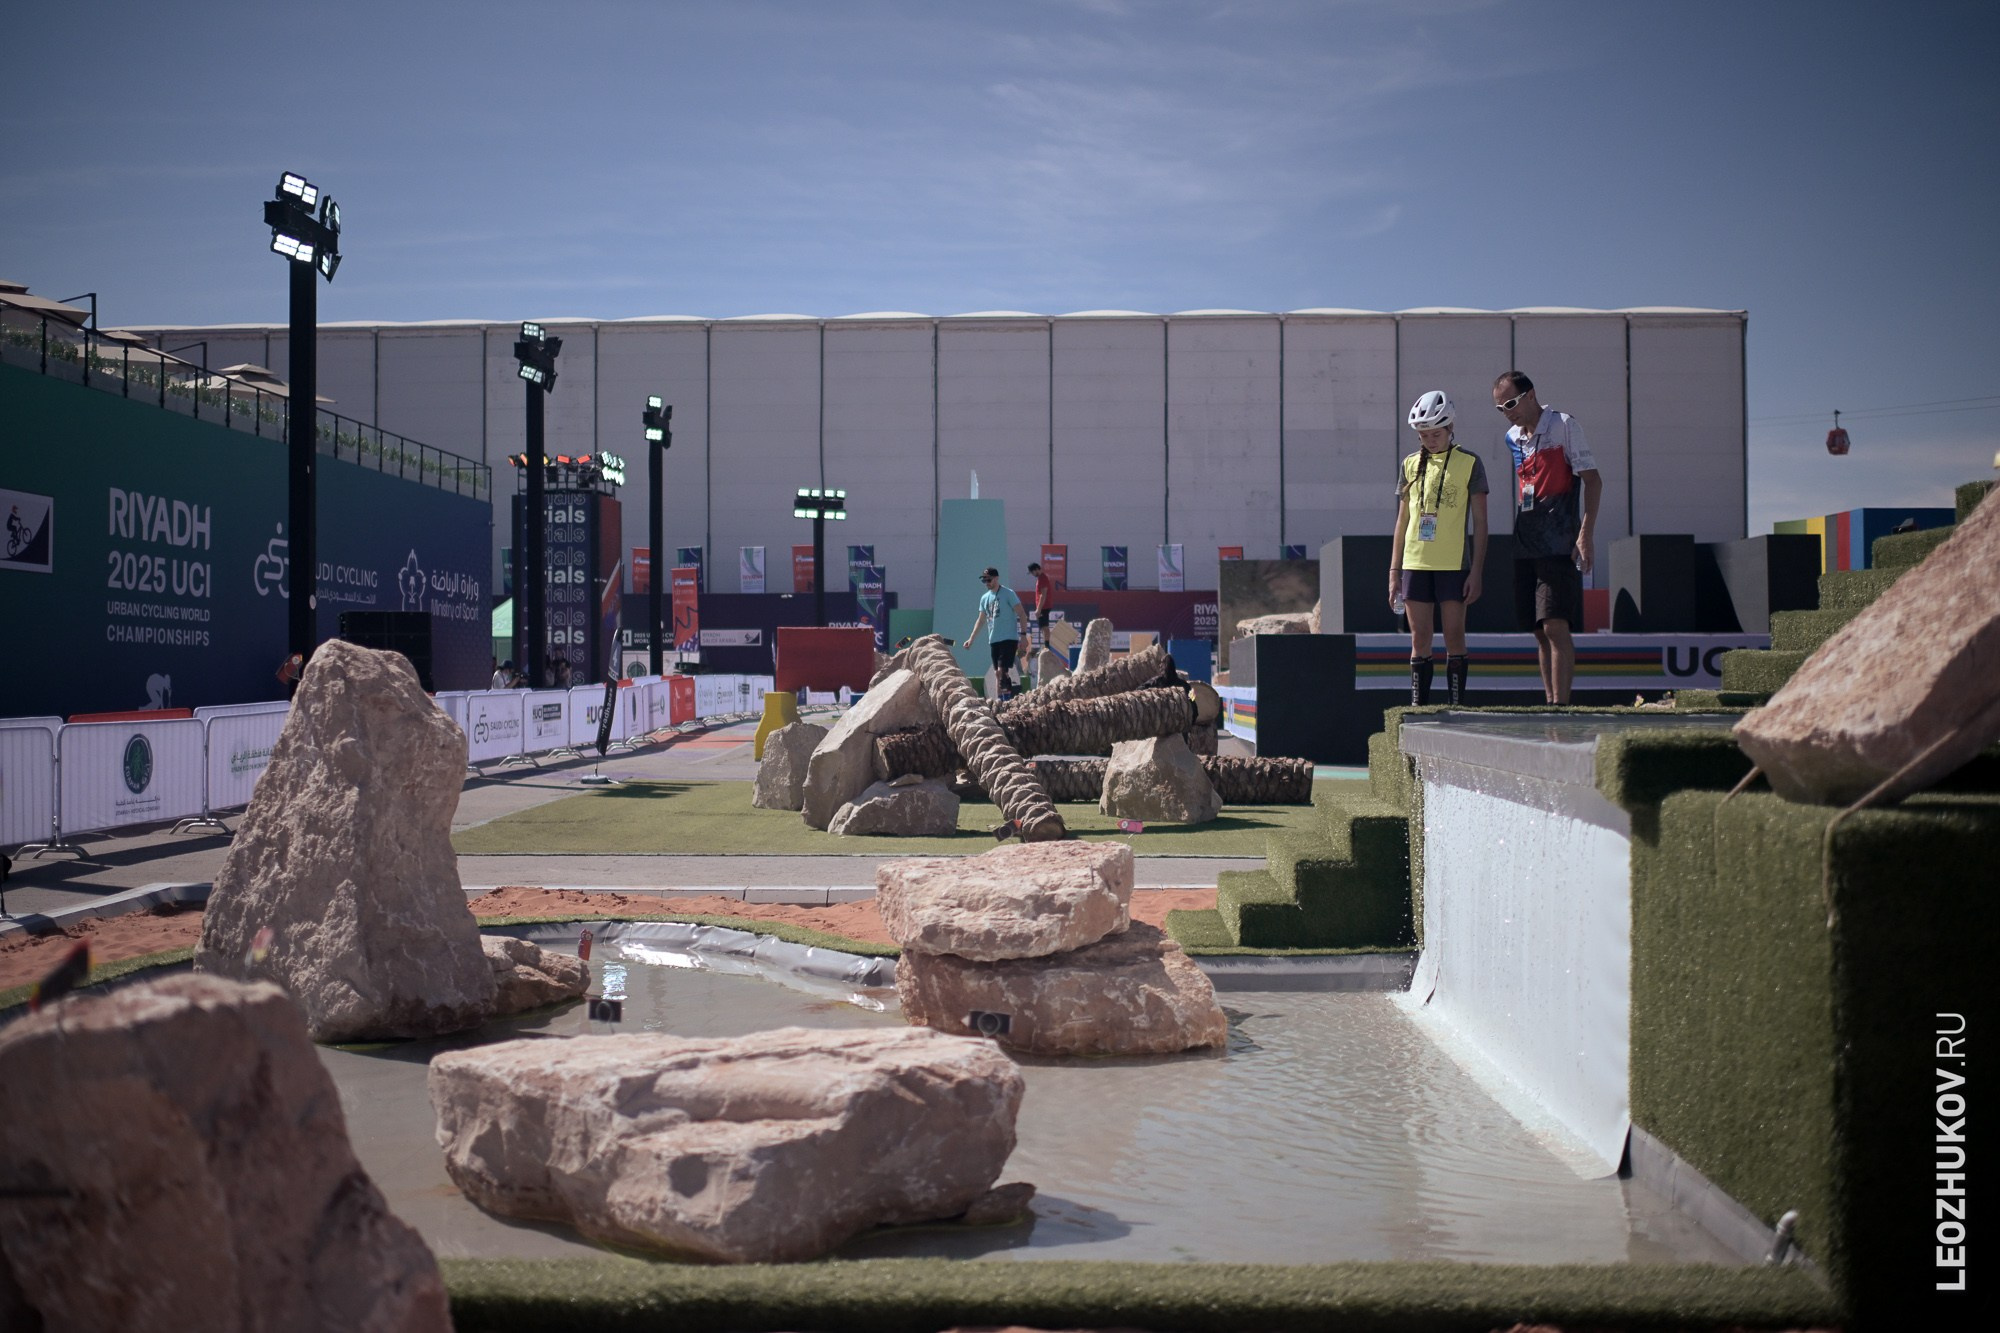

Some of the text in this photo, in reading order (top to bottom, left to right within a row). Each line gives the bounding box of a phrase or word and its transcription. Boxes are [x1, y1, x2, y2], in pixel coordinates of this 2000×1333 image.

[109, 487, 211, 551] RIYADH
[108, 550, 211, 598] 2025 UCI
[315, 562, 378, 588] UDI CYCLING
[431, 569, 479, 601] وزارة الرياضة
[107, 601, 210, 622] URBAN CYCLING WORLD
[430, 597, 479, 623] Ministry of Sport
[544, 607, 586, 626] ials
[1193, 603, 1219, 615] RIYA
[1194, 616, 1217, 626] 2025
[106, 624, 210, 646] CHAMPIONSHIPS
[545, 625, 586, 645] ials
[1667, 646, 1732, 677] UC
[590, 706, 603, 724] UC
